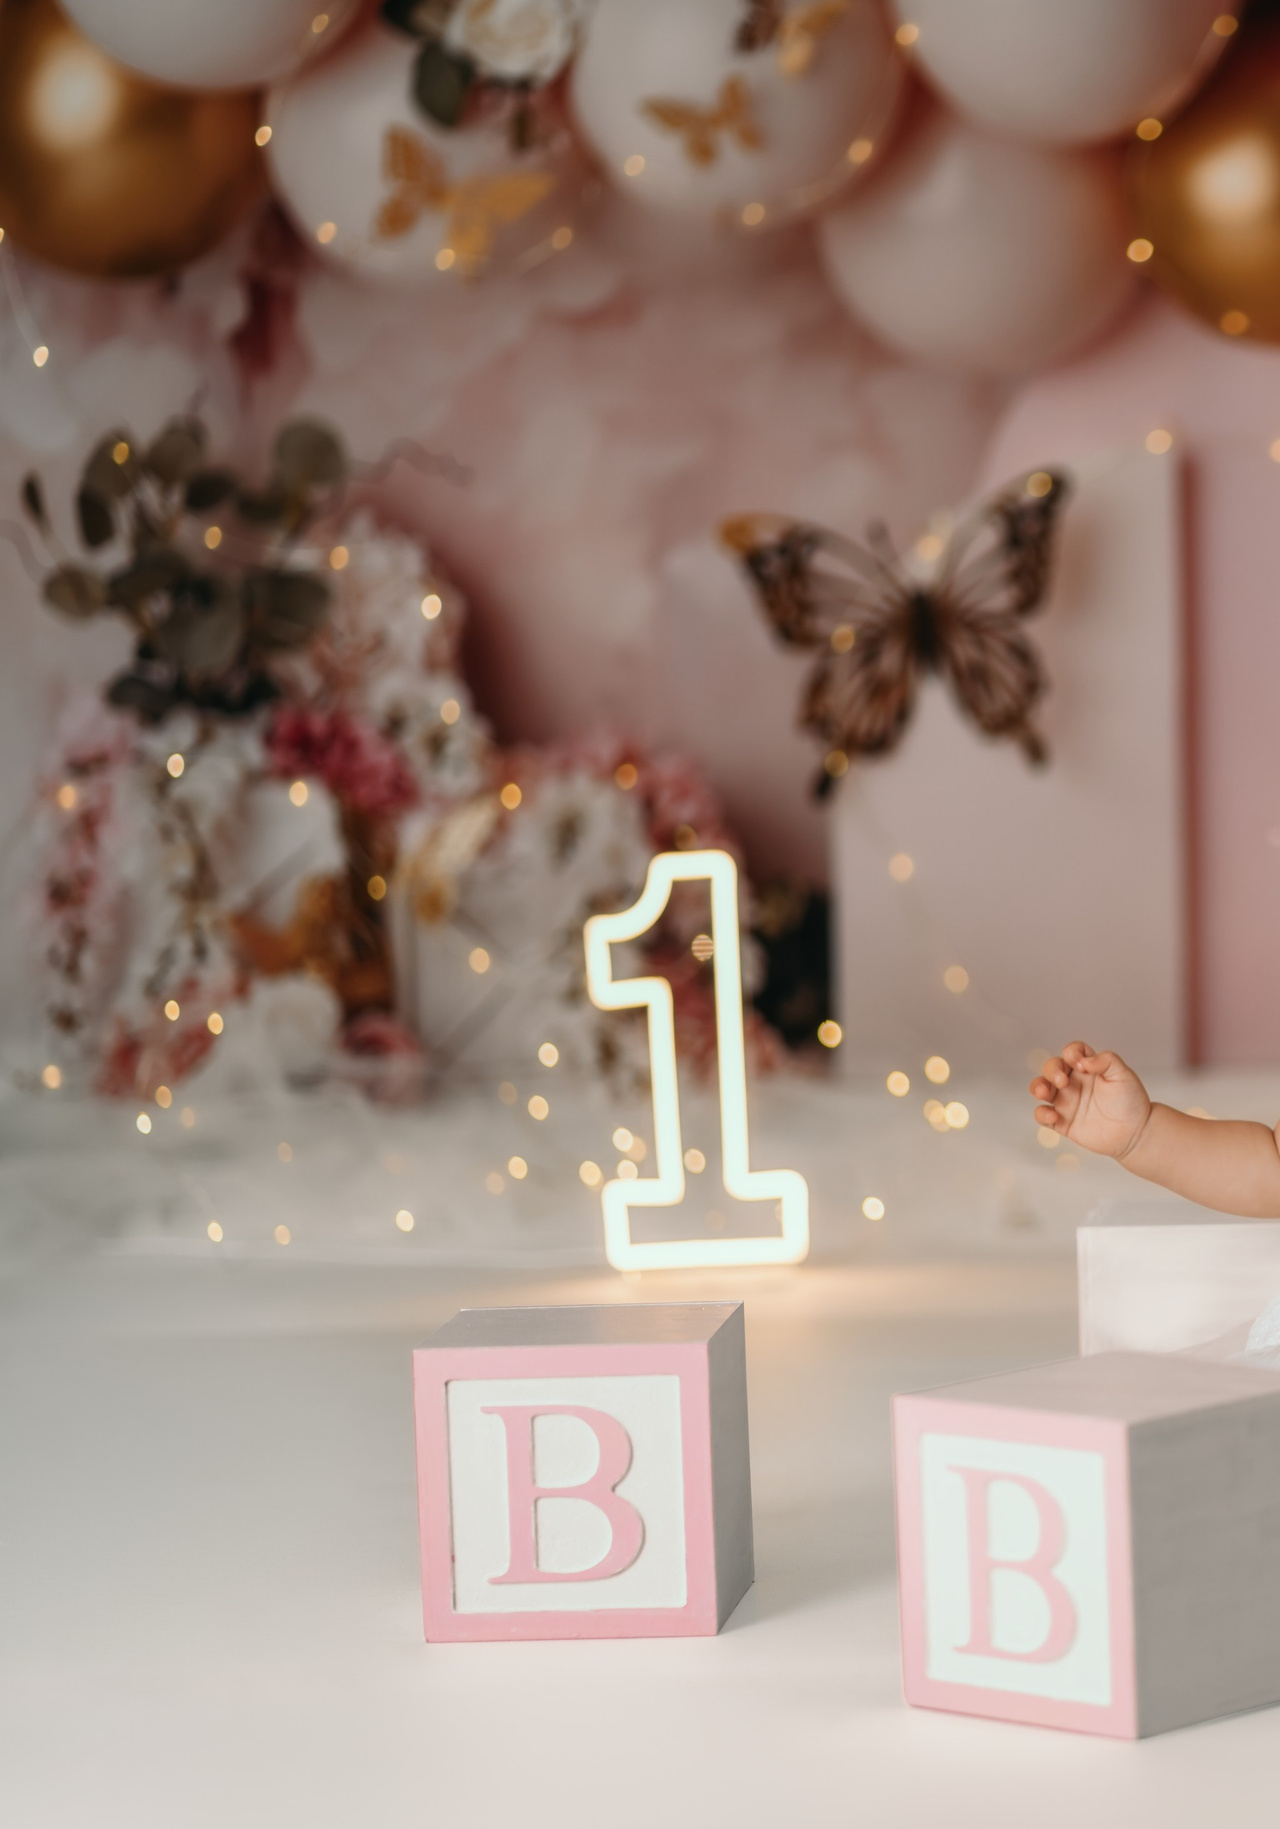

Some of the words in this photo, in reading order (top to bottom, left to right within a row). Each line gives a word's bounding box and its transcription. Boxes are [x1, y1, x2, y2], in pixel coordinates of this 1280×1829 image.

[584, 849, 809, 1271] 1
[480, 1404, 646, 1585] B
[944, 1464, 1079, 1665] B
